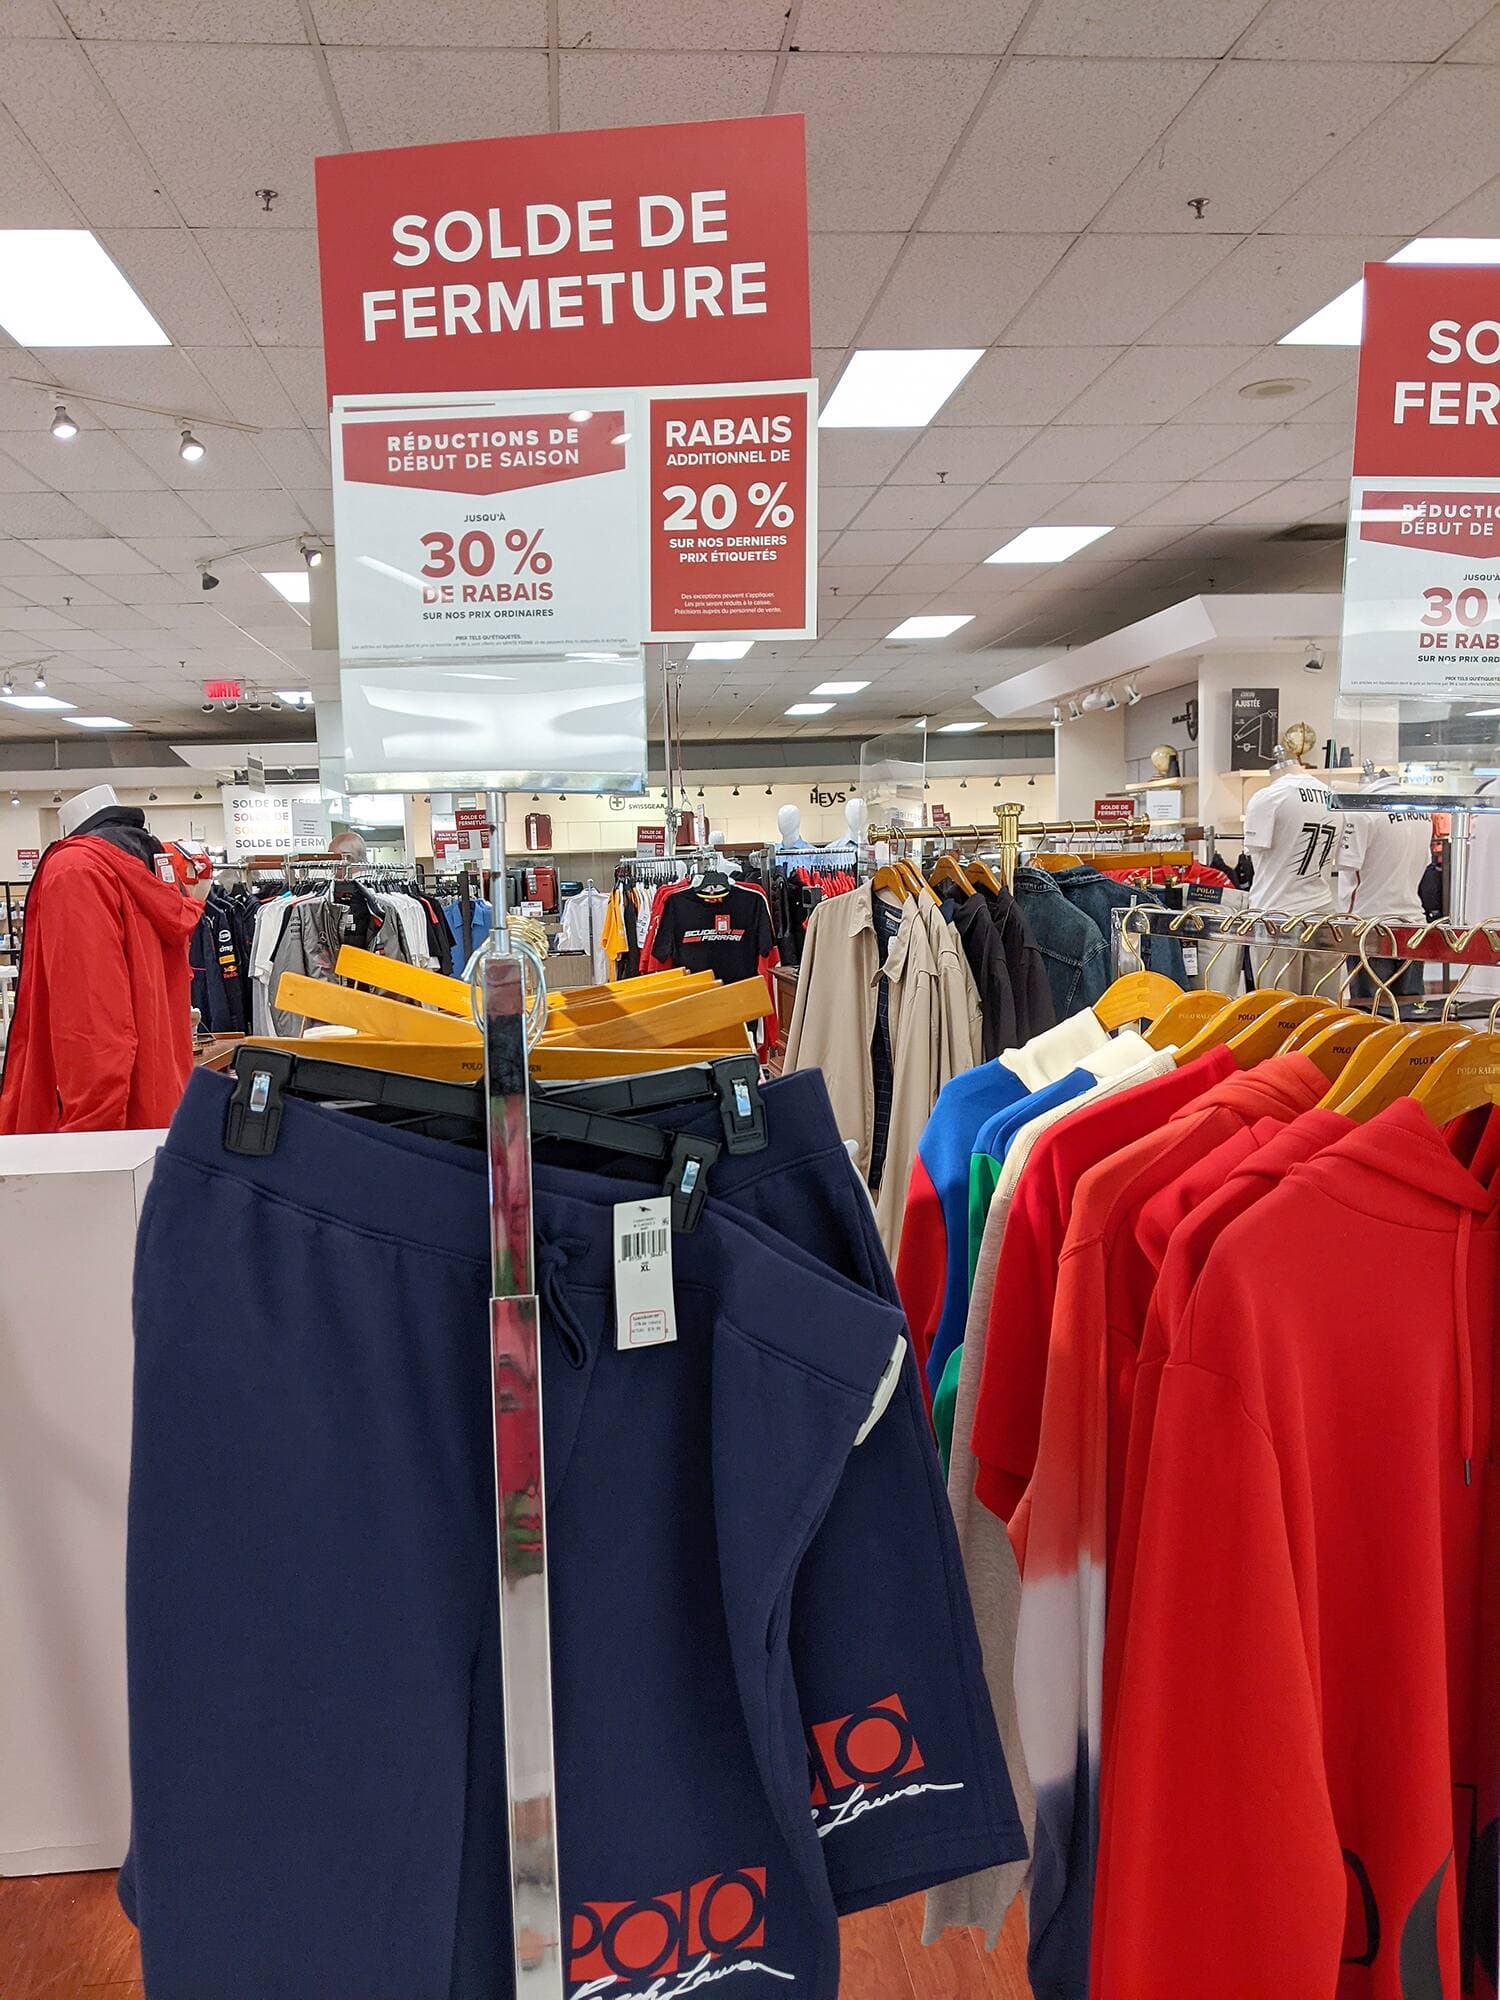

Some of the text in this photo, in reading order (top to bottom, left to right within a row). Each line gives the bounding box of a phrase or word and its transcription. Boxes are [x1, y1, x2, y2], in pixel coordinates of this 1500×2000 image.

[392, 189, 728, 267] SOLDE DE
[362, 261, 767, 342] FERMETURE
[1393, 381, 1500, 425] FER
[665, 415, 792, 448] RABAIS
[387, 428, 579, 452] RÉDUCTIONS DE
[388, 449, 579, 472] DÉBUT DE SAISON
[666, 449, 790, 466] ADDITIONNEL DE
[662, 481, 795, 531] 20 %
[463, 512, 506, 523] JUSQU'À
[1401, 519, 1493, 536] DÉBUT DE
[669, 535, 787, 548] SUR NOS DERNIERS
[420, 528, 553, 578] 30 %
[679, 550, 777, 563] PRIX ÉTIQUETÉS
[423, 582, 554, 604] DE RABAIS
[693, 593, 721, 601] exceptions
[1420, 586, 1488, 628] 30
[422, 608, 554, 620] SUR NOS PRIX ORDINAIRES
[1419, 632, 1500, 649] DE RAB
[1458, 655, 1479, 663] PRIX
[206, 682, 241, 699] SORTIE
[232, 799, 269, 809] SOLDE
[273, 799, 288, 808] DE
[235, 839, 272, 848] SOLDE
[275, 839, 291, 847] DE
[1196, 886, 1215, 895] POLO
[701, 934, 742, 942] FERRARI
[1238, 1013, 1255, 1021] POLO
[1278, 1020, 1295, 1029] POLO
[1332, 1046, 1351, 1054] POLO
[462, 1062, 483, 1071] POLO
[1409, 1057, 1429, 1066] POLO
[1457, 1067, 1477, 1075] POLO
[641, 1264, 651, 1272] XL
[560, 1867, 767, 1983] POLO
